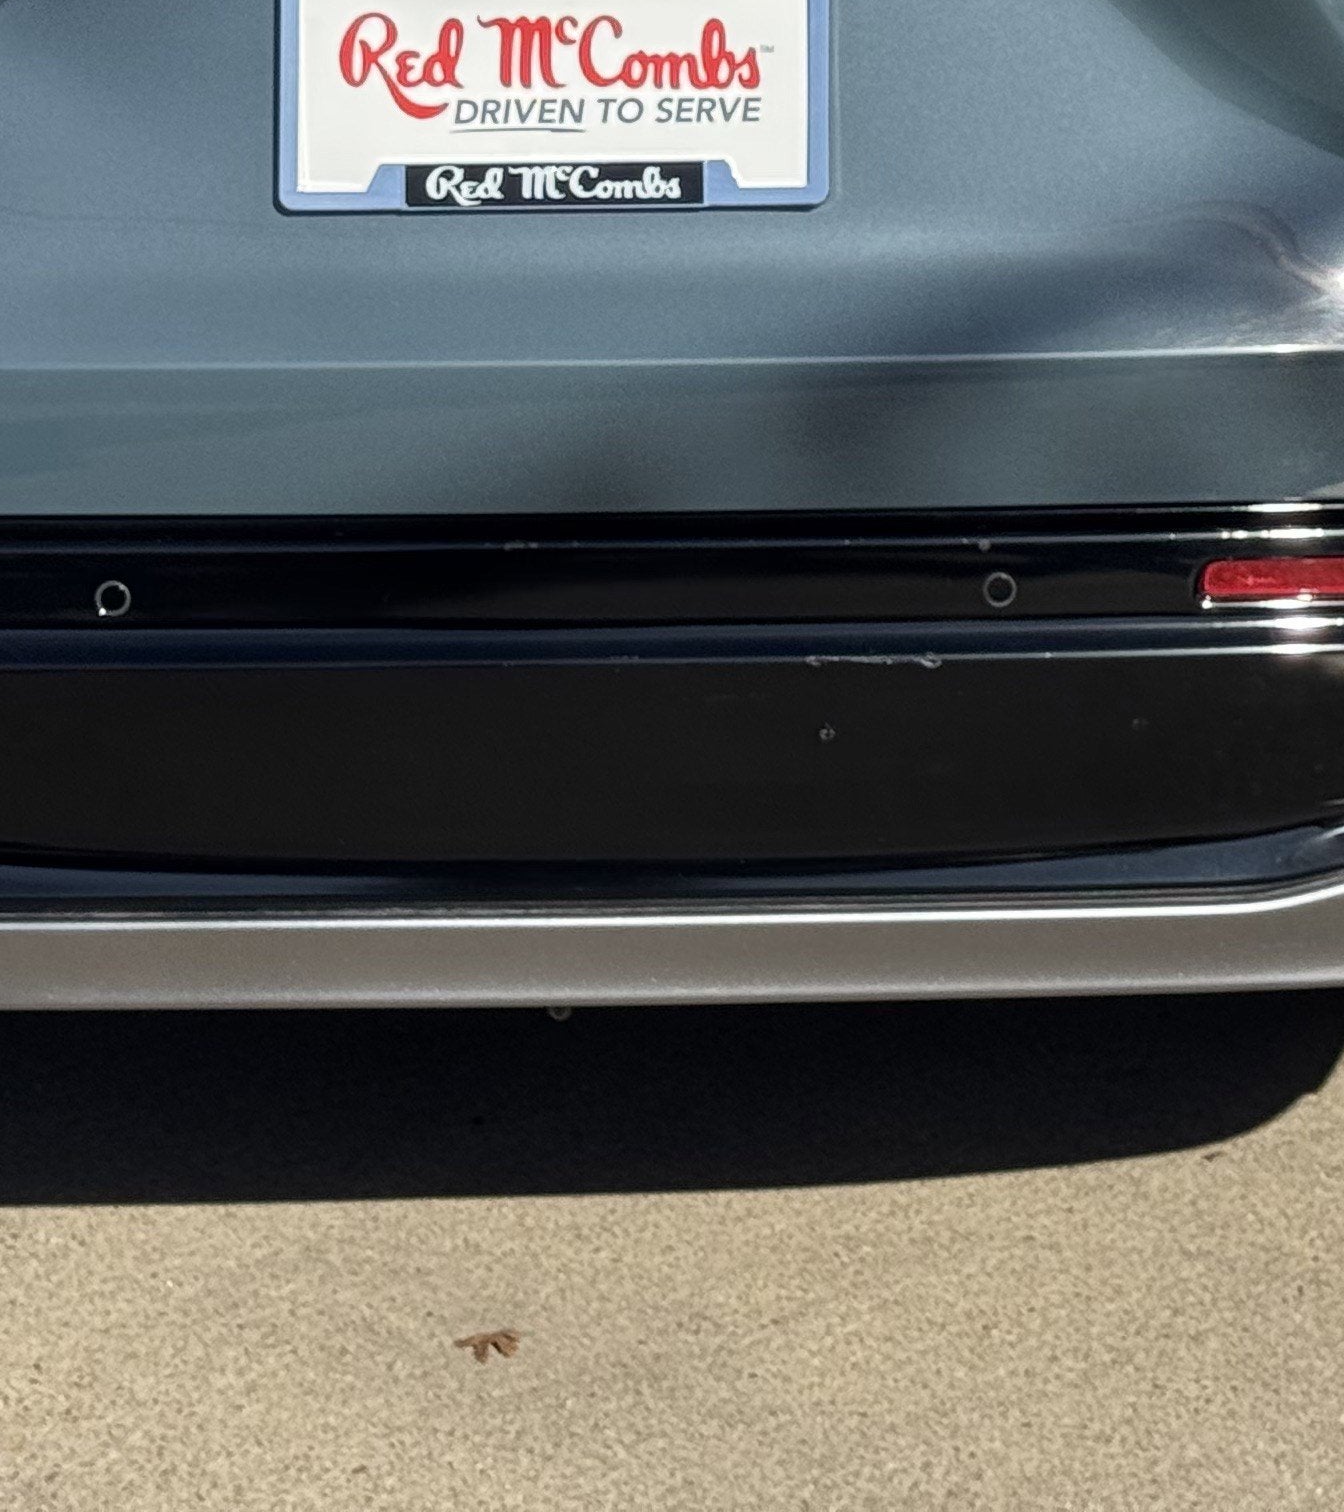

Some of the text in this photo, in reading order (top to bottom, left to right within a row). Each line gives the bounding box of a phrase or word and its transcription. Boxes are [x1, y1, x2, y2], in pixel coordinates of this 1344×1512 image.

[339, 12, 761, 119] Red McCombs
[454, 96, 762, 125] DRIVEN TO SERVE
[425, 164, 682, 206] Red McCombs
